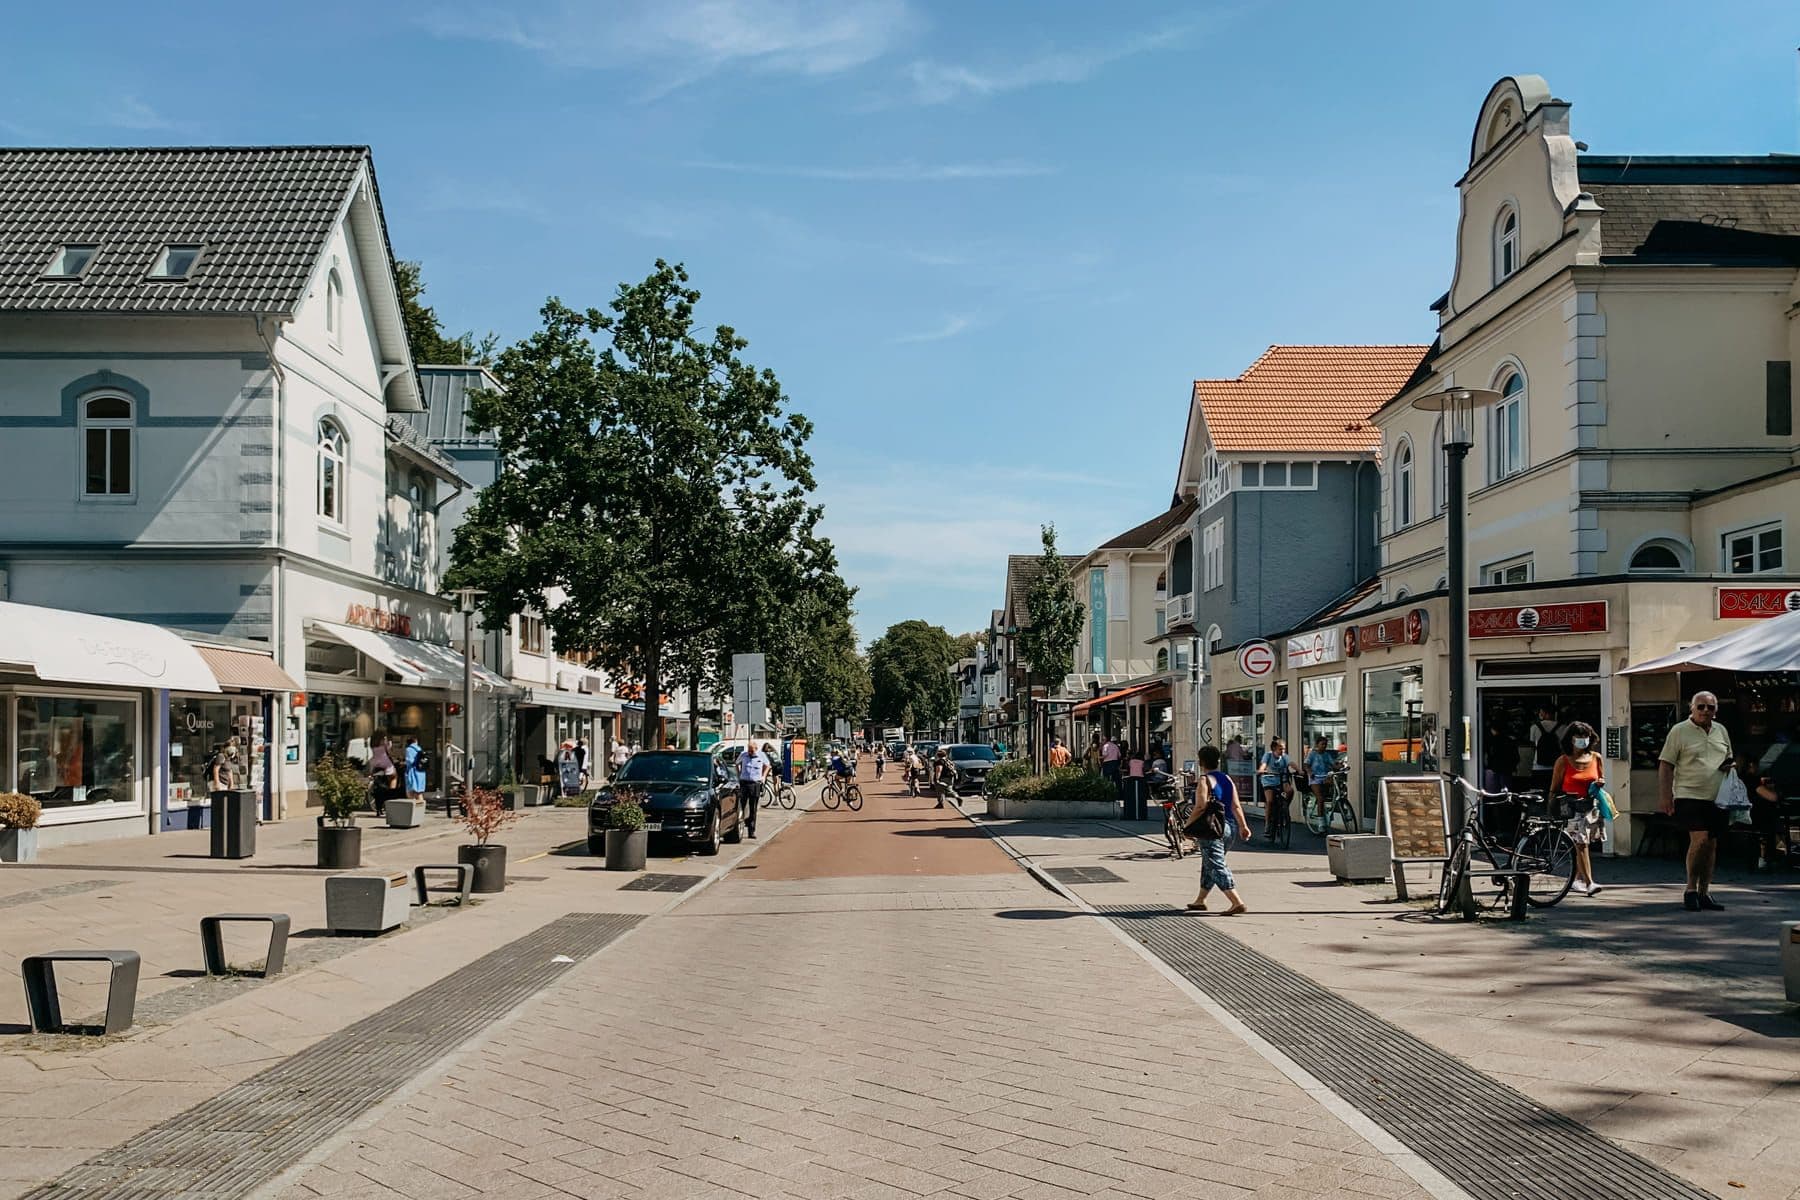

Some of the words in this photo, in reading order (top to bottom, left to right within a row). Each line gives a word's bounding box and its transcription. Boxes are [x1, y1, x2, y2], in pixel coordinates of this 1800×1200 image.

[1721, 592, 1781, 610] OSAKA
[1541, 604, 1585, 624] SUSHI
[1244, 646, 1272, 675] G
